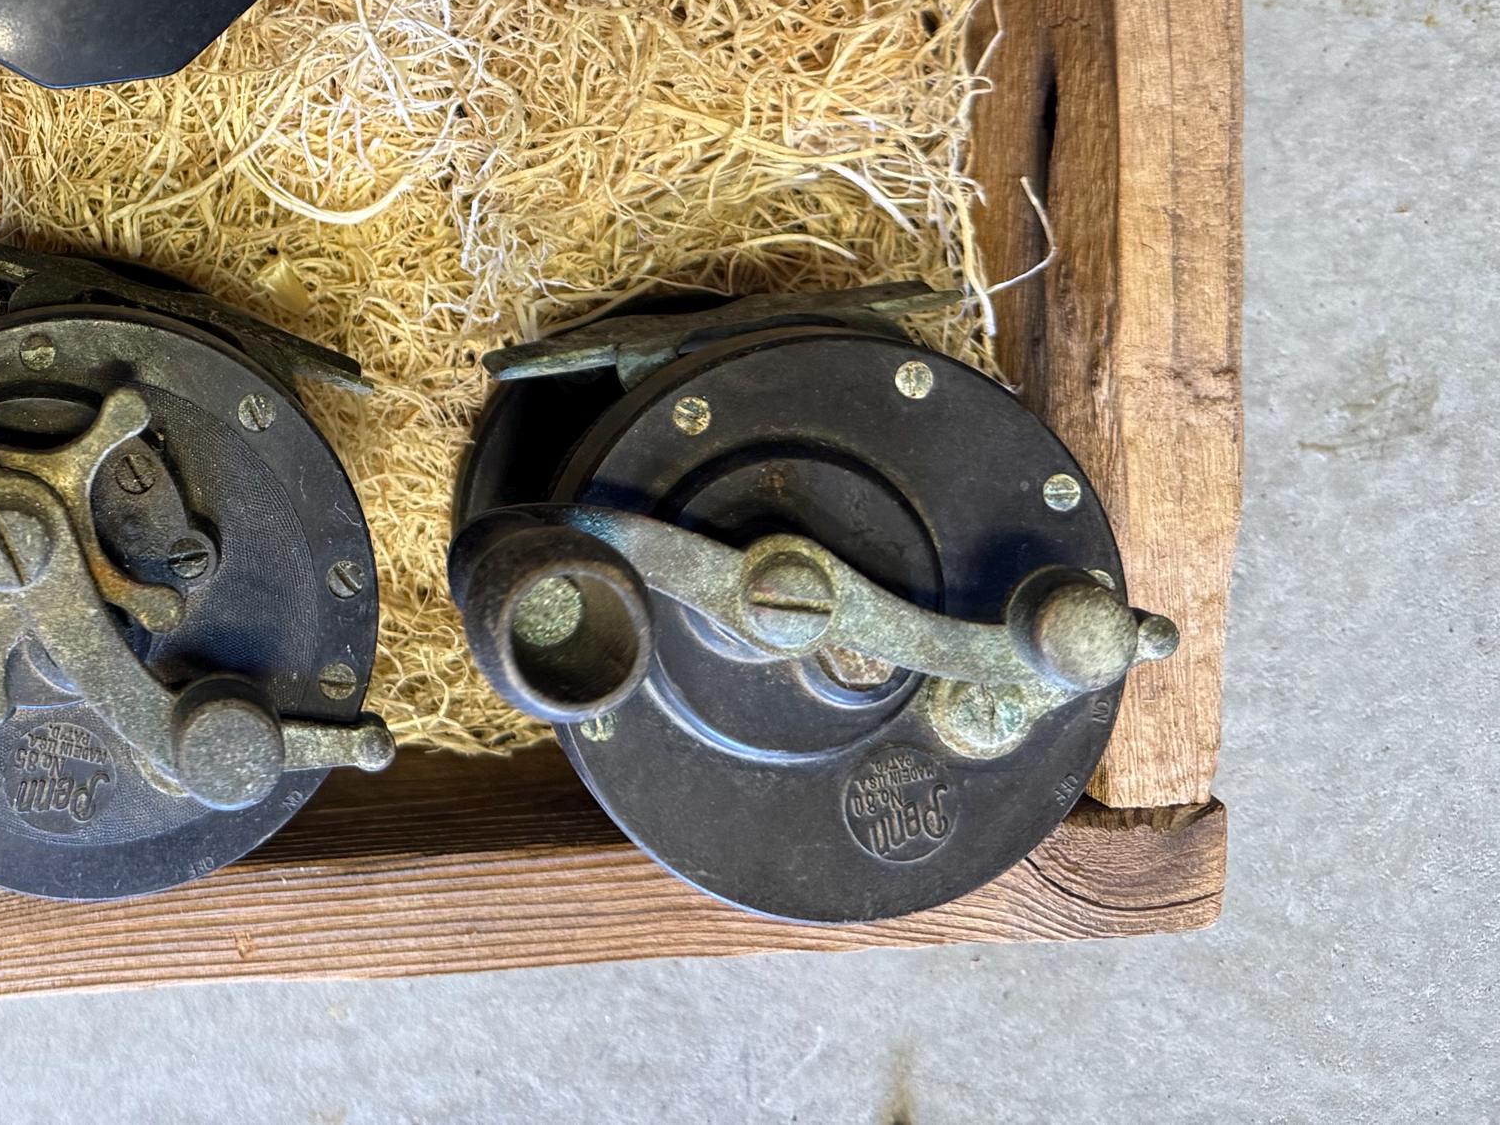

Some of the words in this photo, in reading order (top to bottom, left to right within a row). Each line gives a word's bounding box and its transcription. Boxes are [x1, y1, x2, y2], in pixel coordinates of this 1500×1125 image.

[1091, 699, 1111, 725] ON
[15, 770, 111, 823] Penn
[868, 782, 950, 856] Penn
